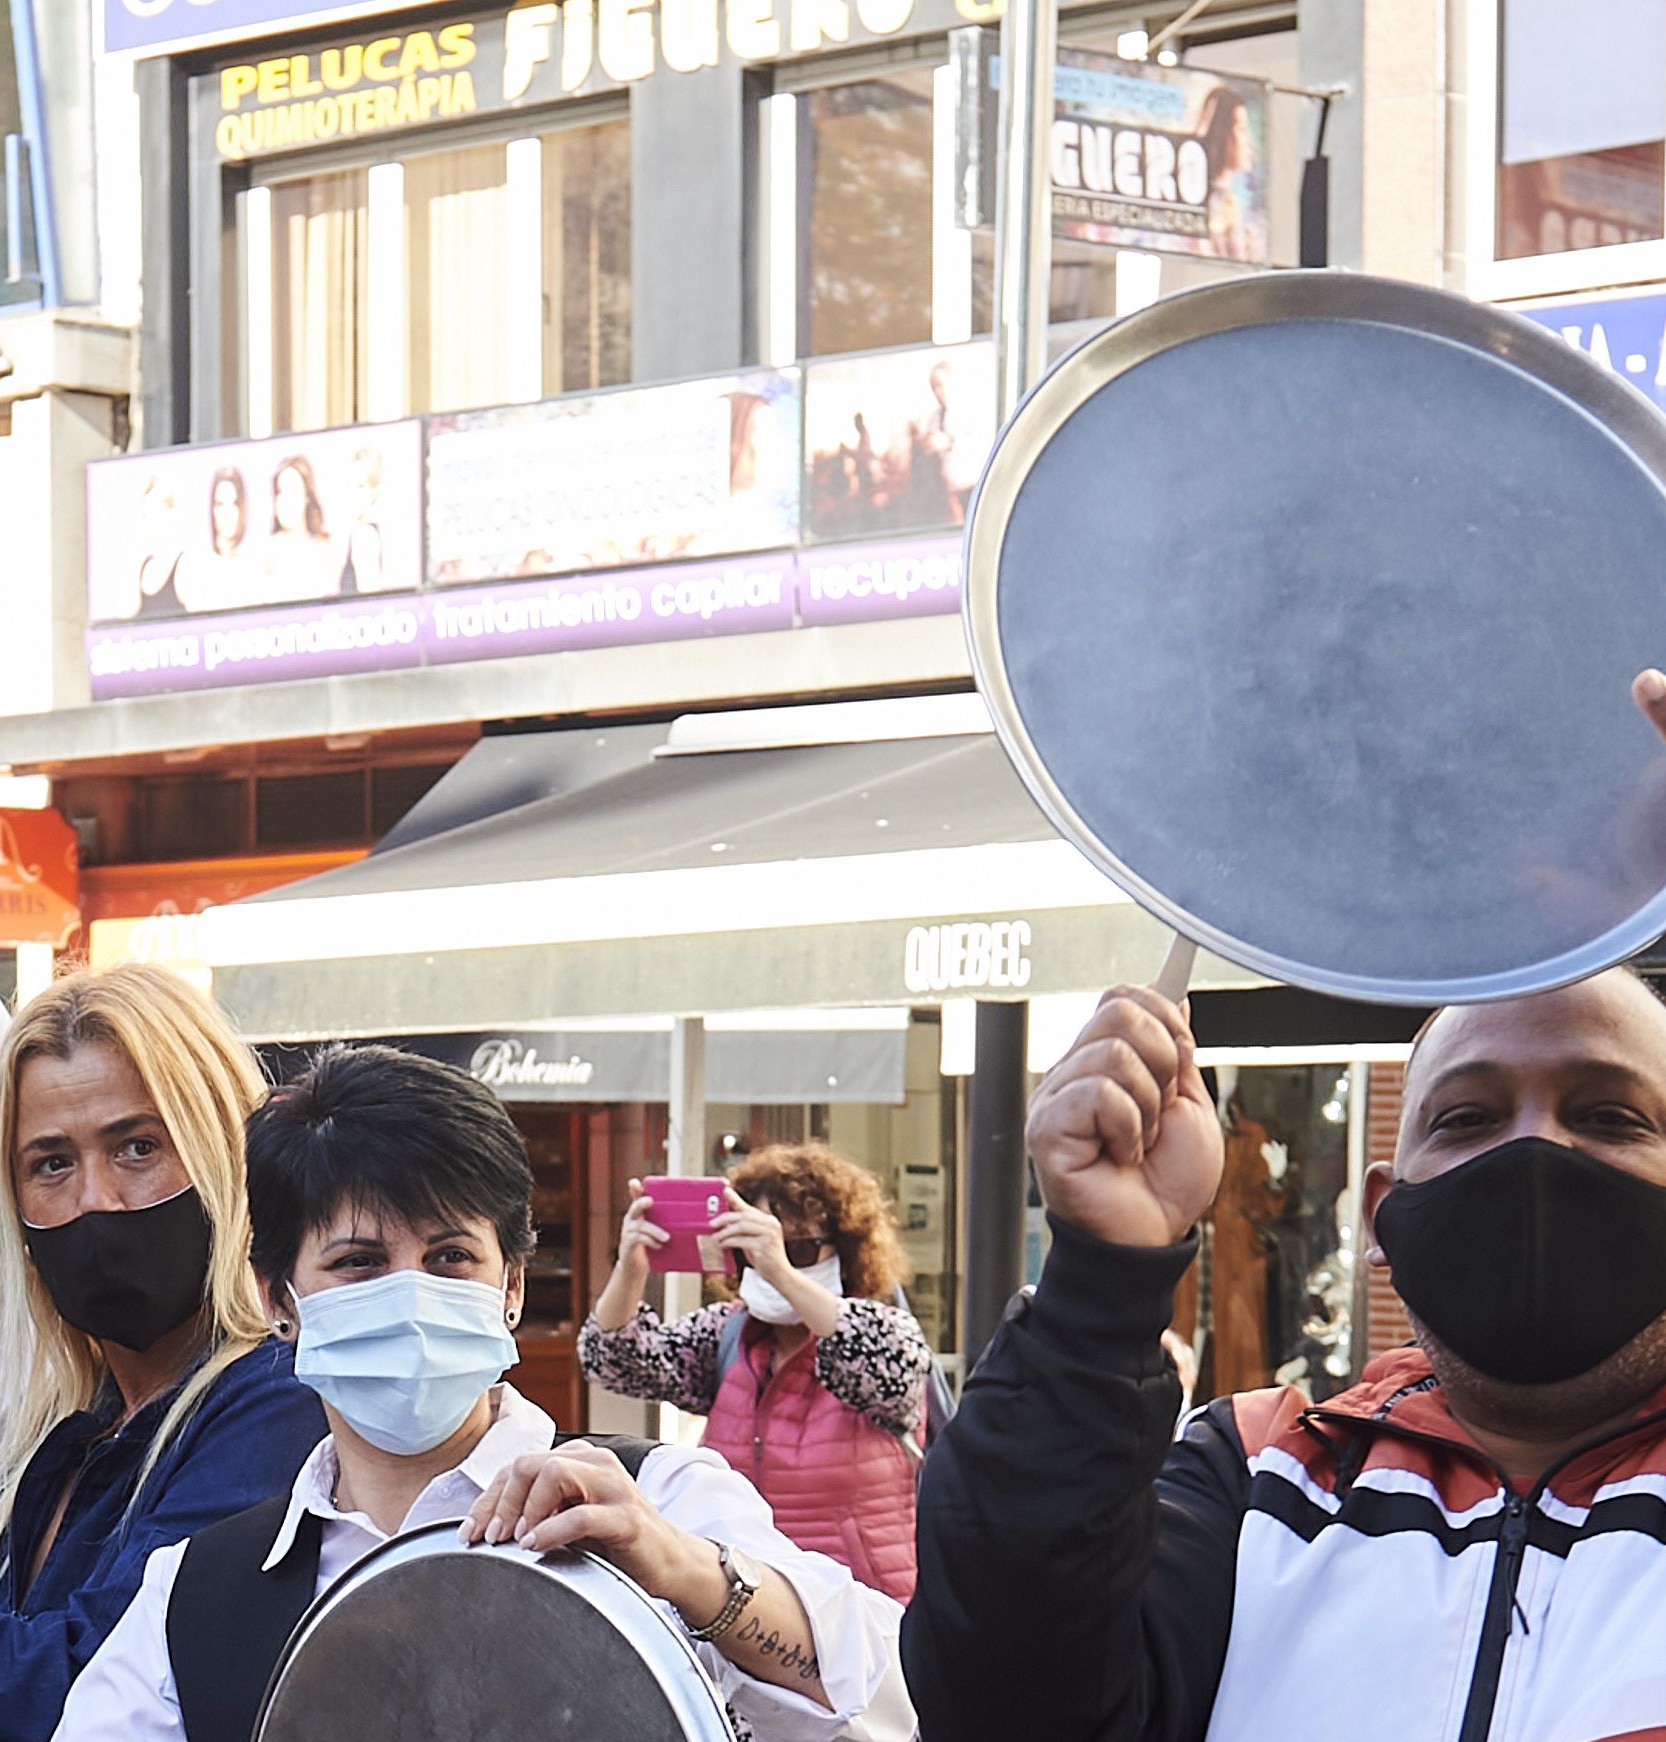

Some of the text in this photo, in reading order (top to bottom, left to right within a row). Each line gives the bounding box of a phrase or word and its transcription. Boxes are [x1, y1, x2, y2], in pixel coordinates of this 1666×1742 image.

[220, 23, 477, 111] PELUCAS
[203, 606, 418, 671] personalizado
[433, 581, 642, 640] tratamiento
[650, 564, 784, 619] capilar
[904, 920, 1032, 993] QUEBEC
[470, 1039, 594, 1086] Bohemia
